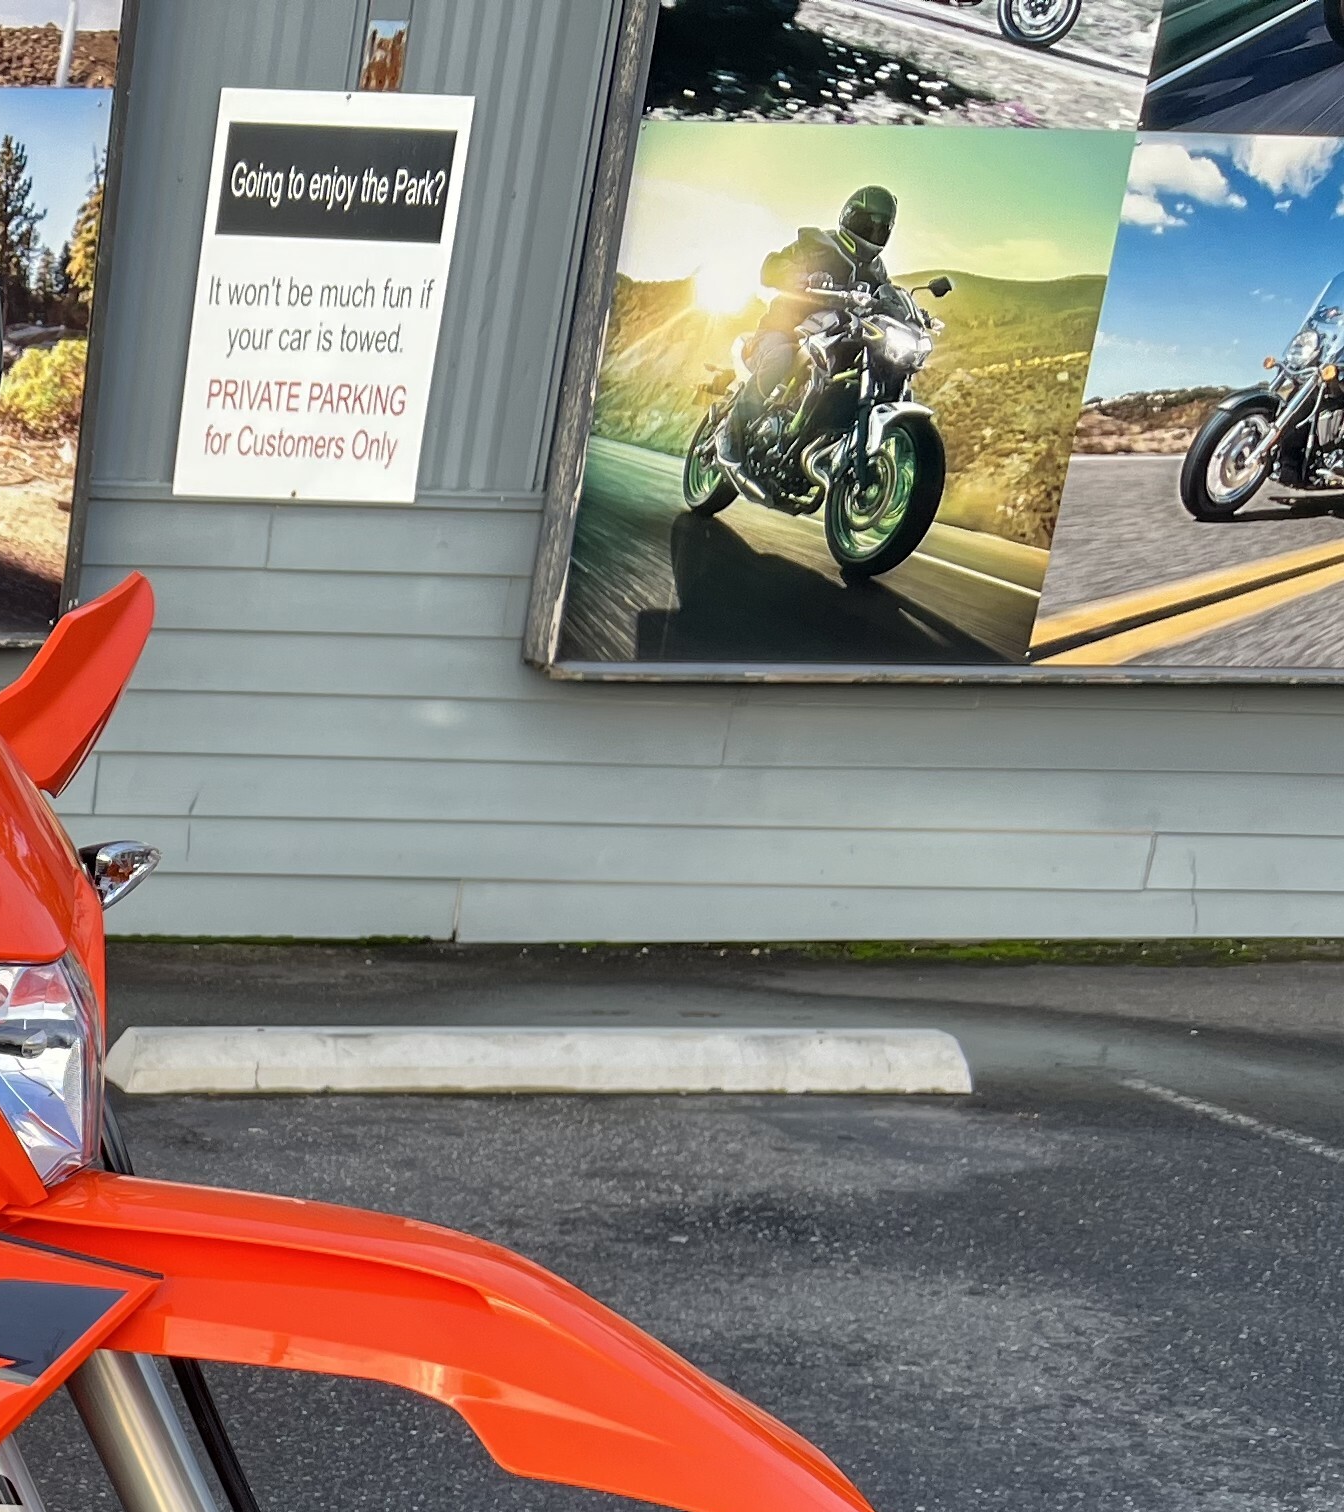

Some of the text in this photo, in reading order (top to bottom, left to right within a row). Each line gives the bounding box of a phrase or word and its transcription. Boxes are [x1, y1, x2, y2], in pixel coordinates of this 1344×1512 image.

[231, 161, 446, 212] Going to enjoy the Park?
[208, 275, 435, 309] It won't be much fun if
[226, 322, 403, 358] your car is towed.
[207, 379, 407, 416] PRIVATE PARKING
[204, 425, 398, 469] for Customers Only
